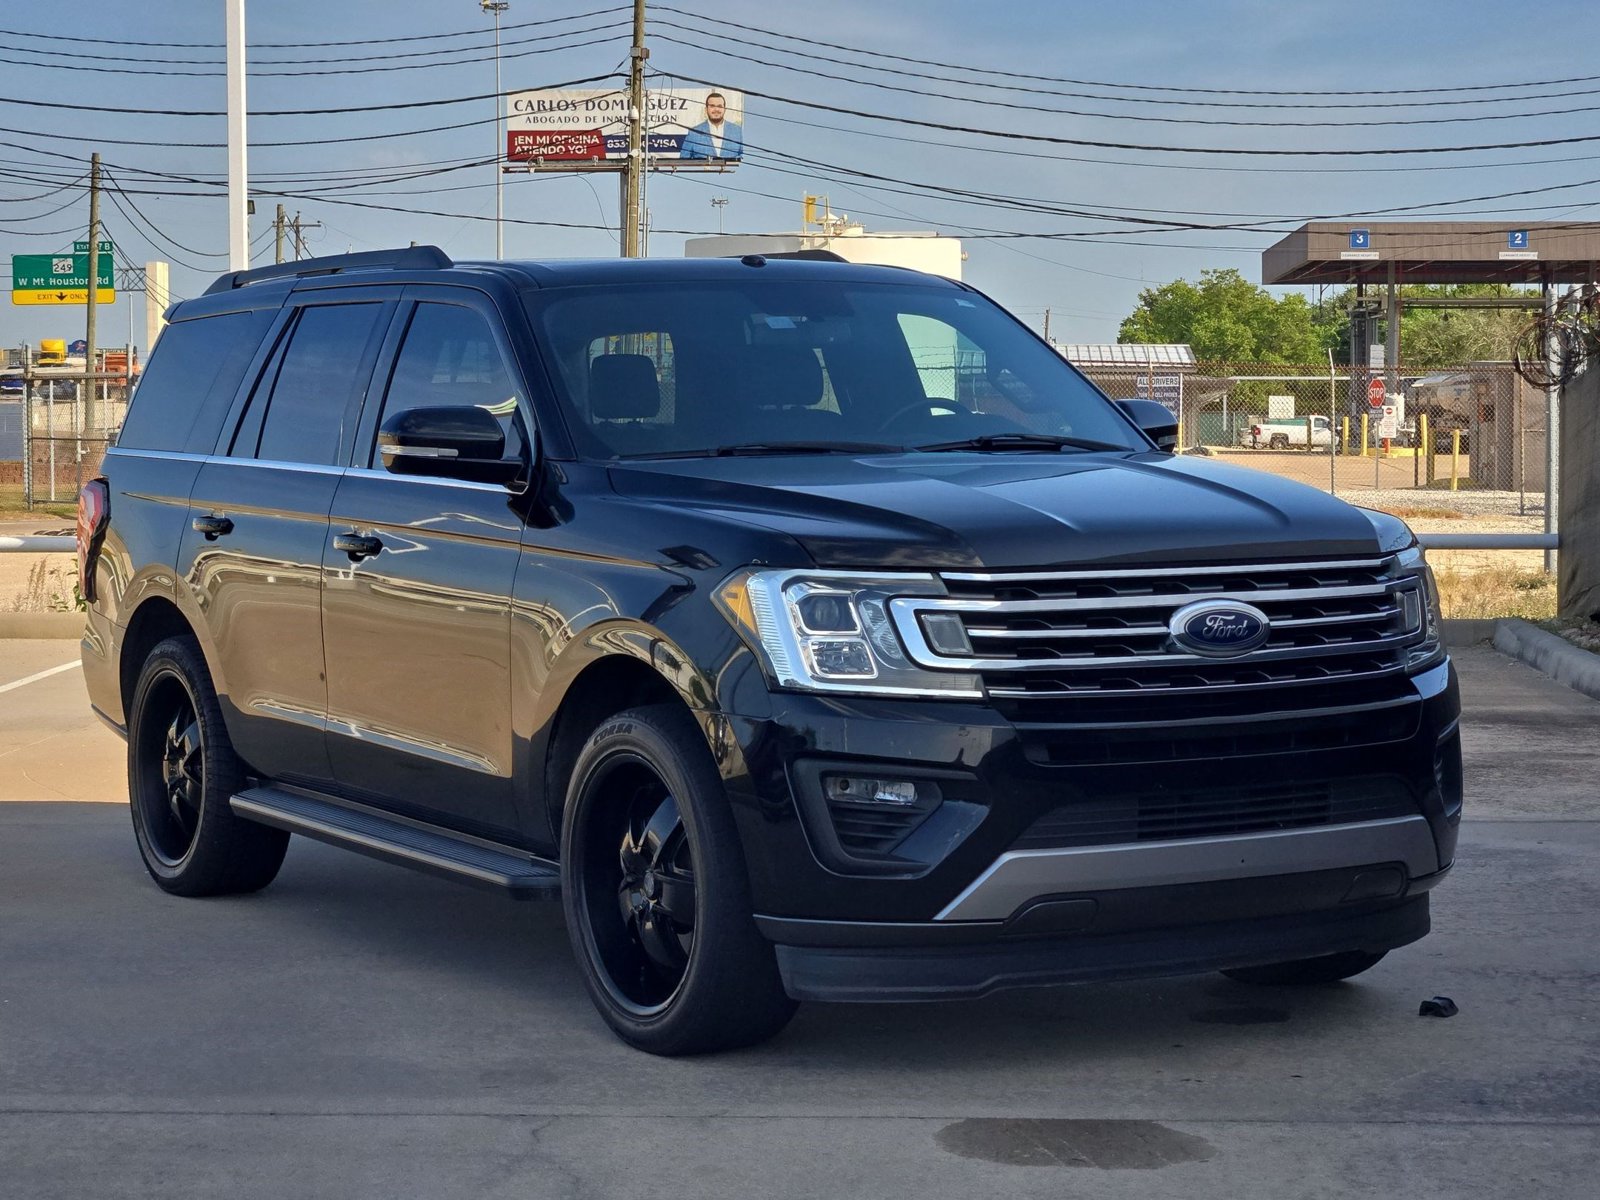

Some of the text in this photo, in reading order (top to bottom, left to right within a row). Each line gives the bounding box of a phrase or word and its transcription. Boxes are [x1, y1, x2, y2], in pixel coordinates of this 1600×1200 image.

[514, 99, 688, 111] CARLOS DOMIGUEZ
[525, 115, 580, 124] ABOGADO
[536, 135, 550, 145] MI
[552, 135, 600, 145] OFICINA
[514, 145, 566, 155] ATIENDO
[1356, 233, 1364, 244] 3
[1514, 232, 1523, 244] 2
[104, 242, 110, 251] B
[54, 263, 72, 273] 249
[18, 277, 28, 286] W
[33, 277, 45, 286] Mt
[1152, 377, 1178, 386] DRIVERS
[1369, 387, 1384, 399] STOP
[1202, 614, 1248, 638] Ford
[593, 722, 635, 746] CORSA
